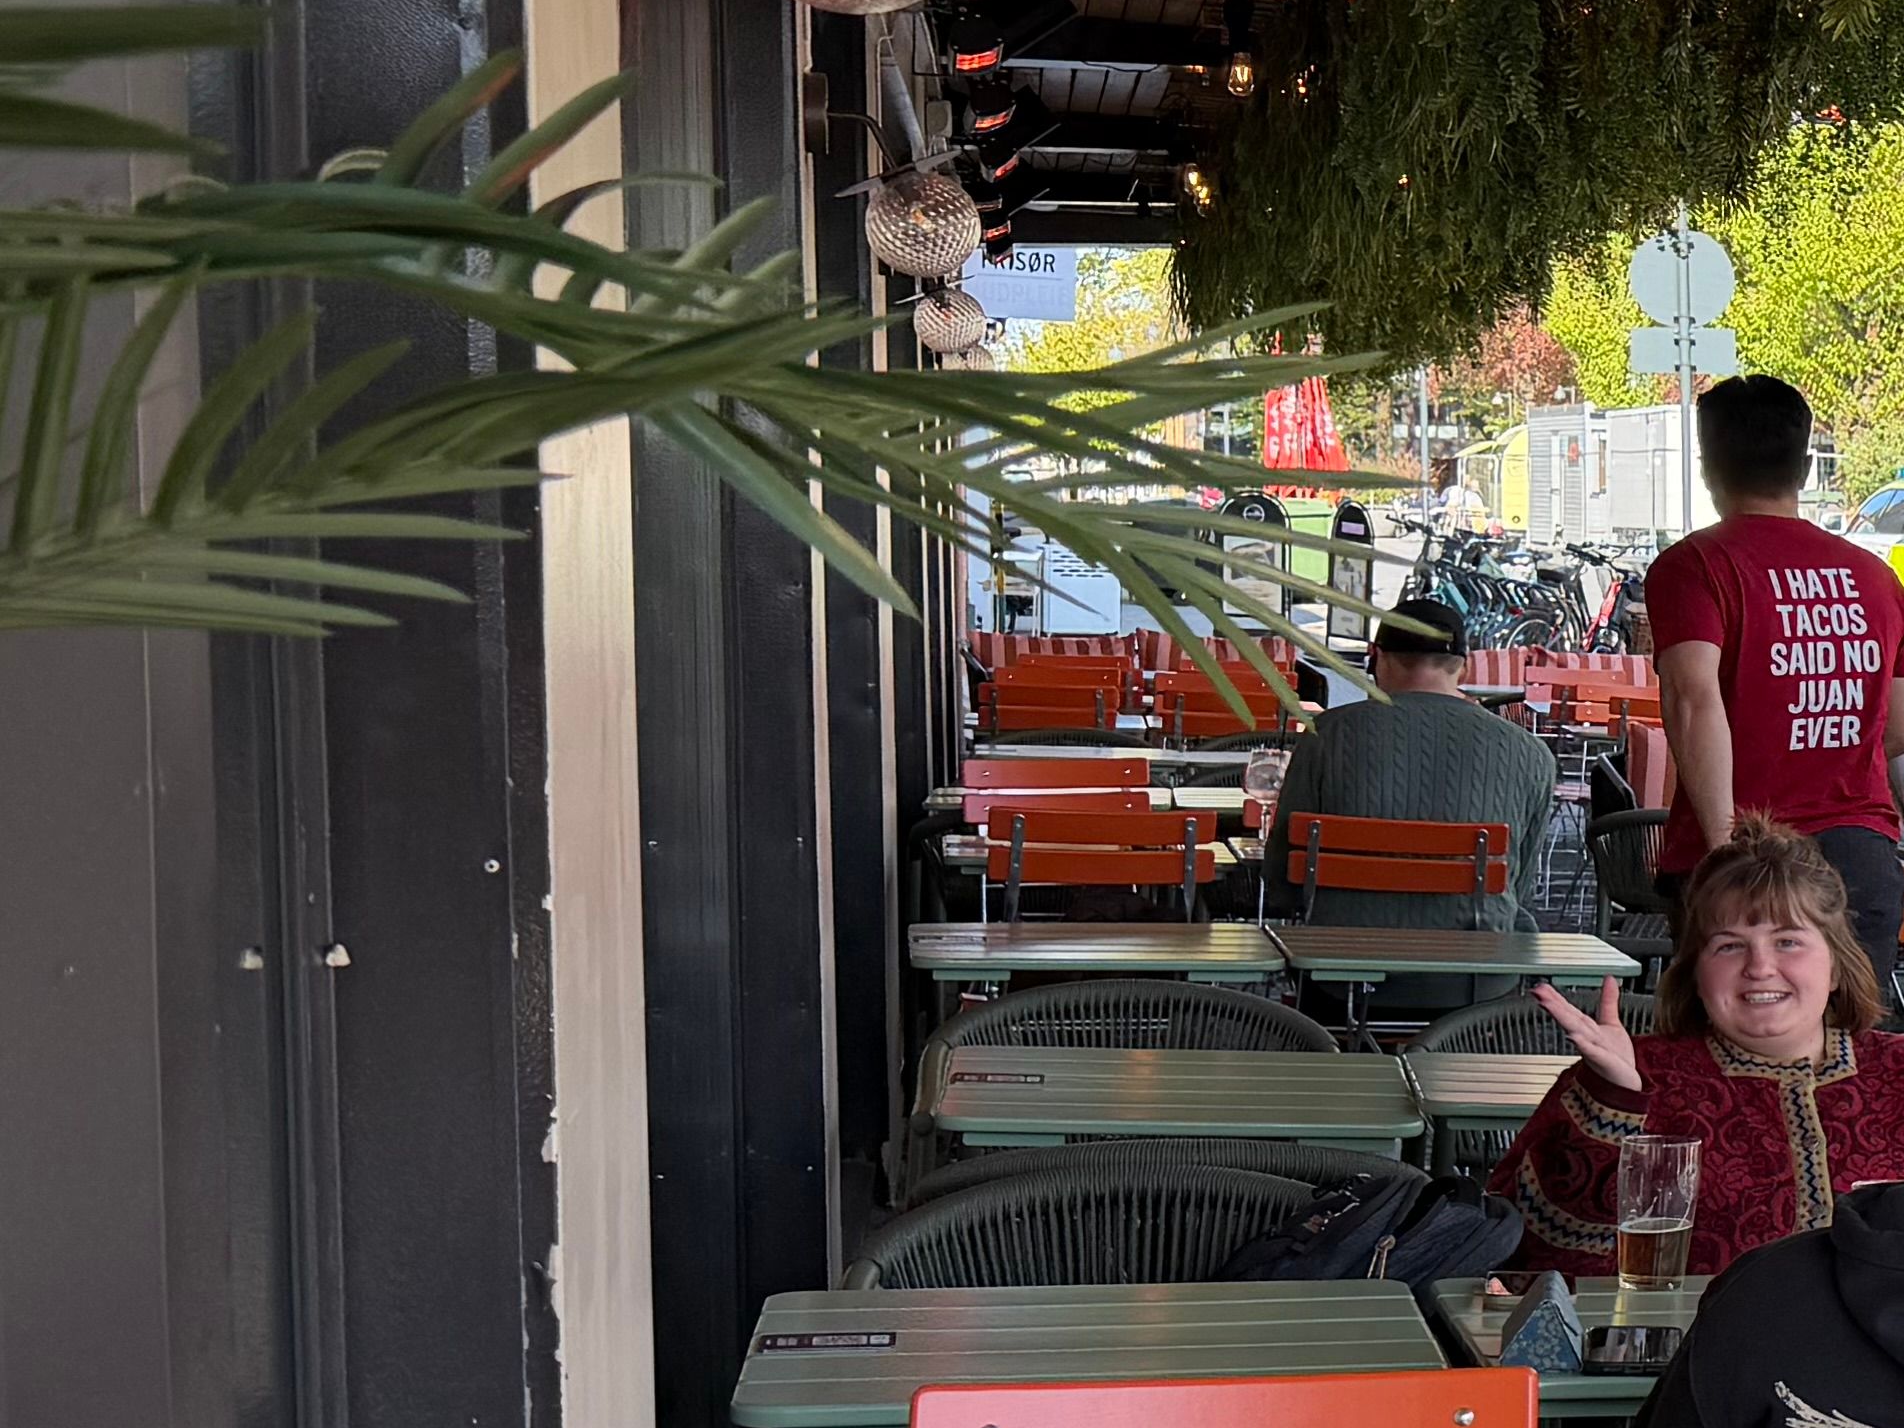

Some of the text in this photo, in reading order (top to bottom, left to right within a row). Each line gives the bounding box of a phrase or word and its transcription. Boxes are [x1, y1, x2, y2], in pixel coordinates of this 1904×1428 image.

[1768, 568, 1859, 599] I HATE
[1775, 603, 1867, 637] TACOS
[1770, 640, 1881, 676] SAID NO
[1788, 679, 1864, 714] JUAN
[1789, 715, 1861, 751] EVER
